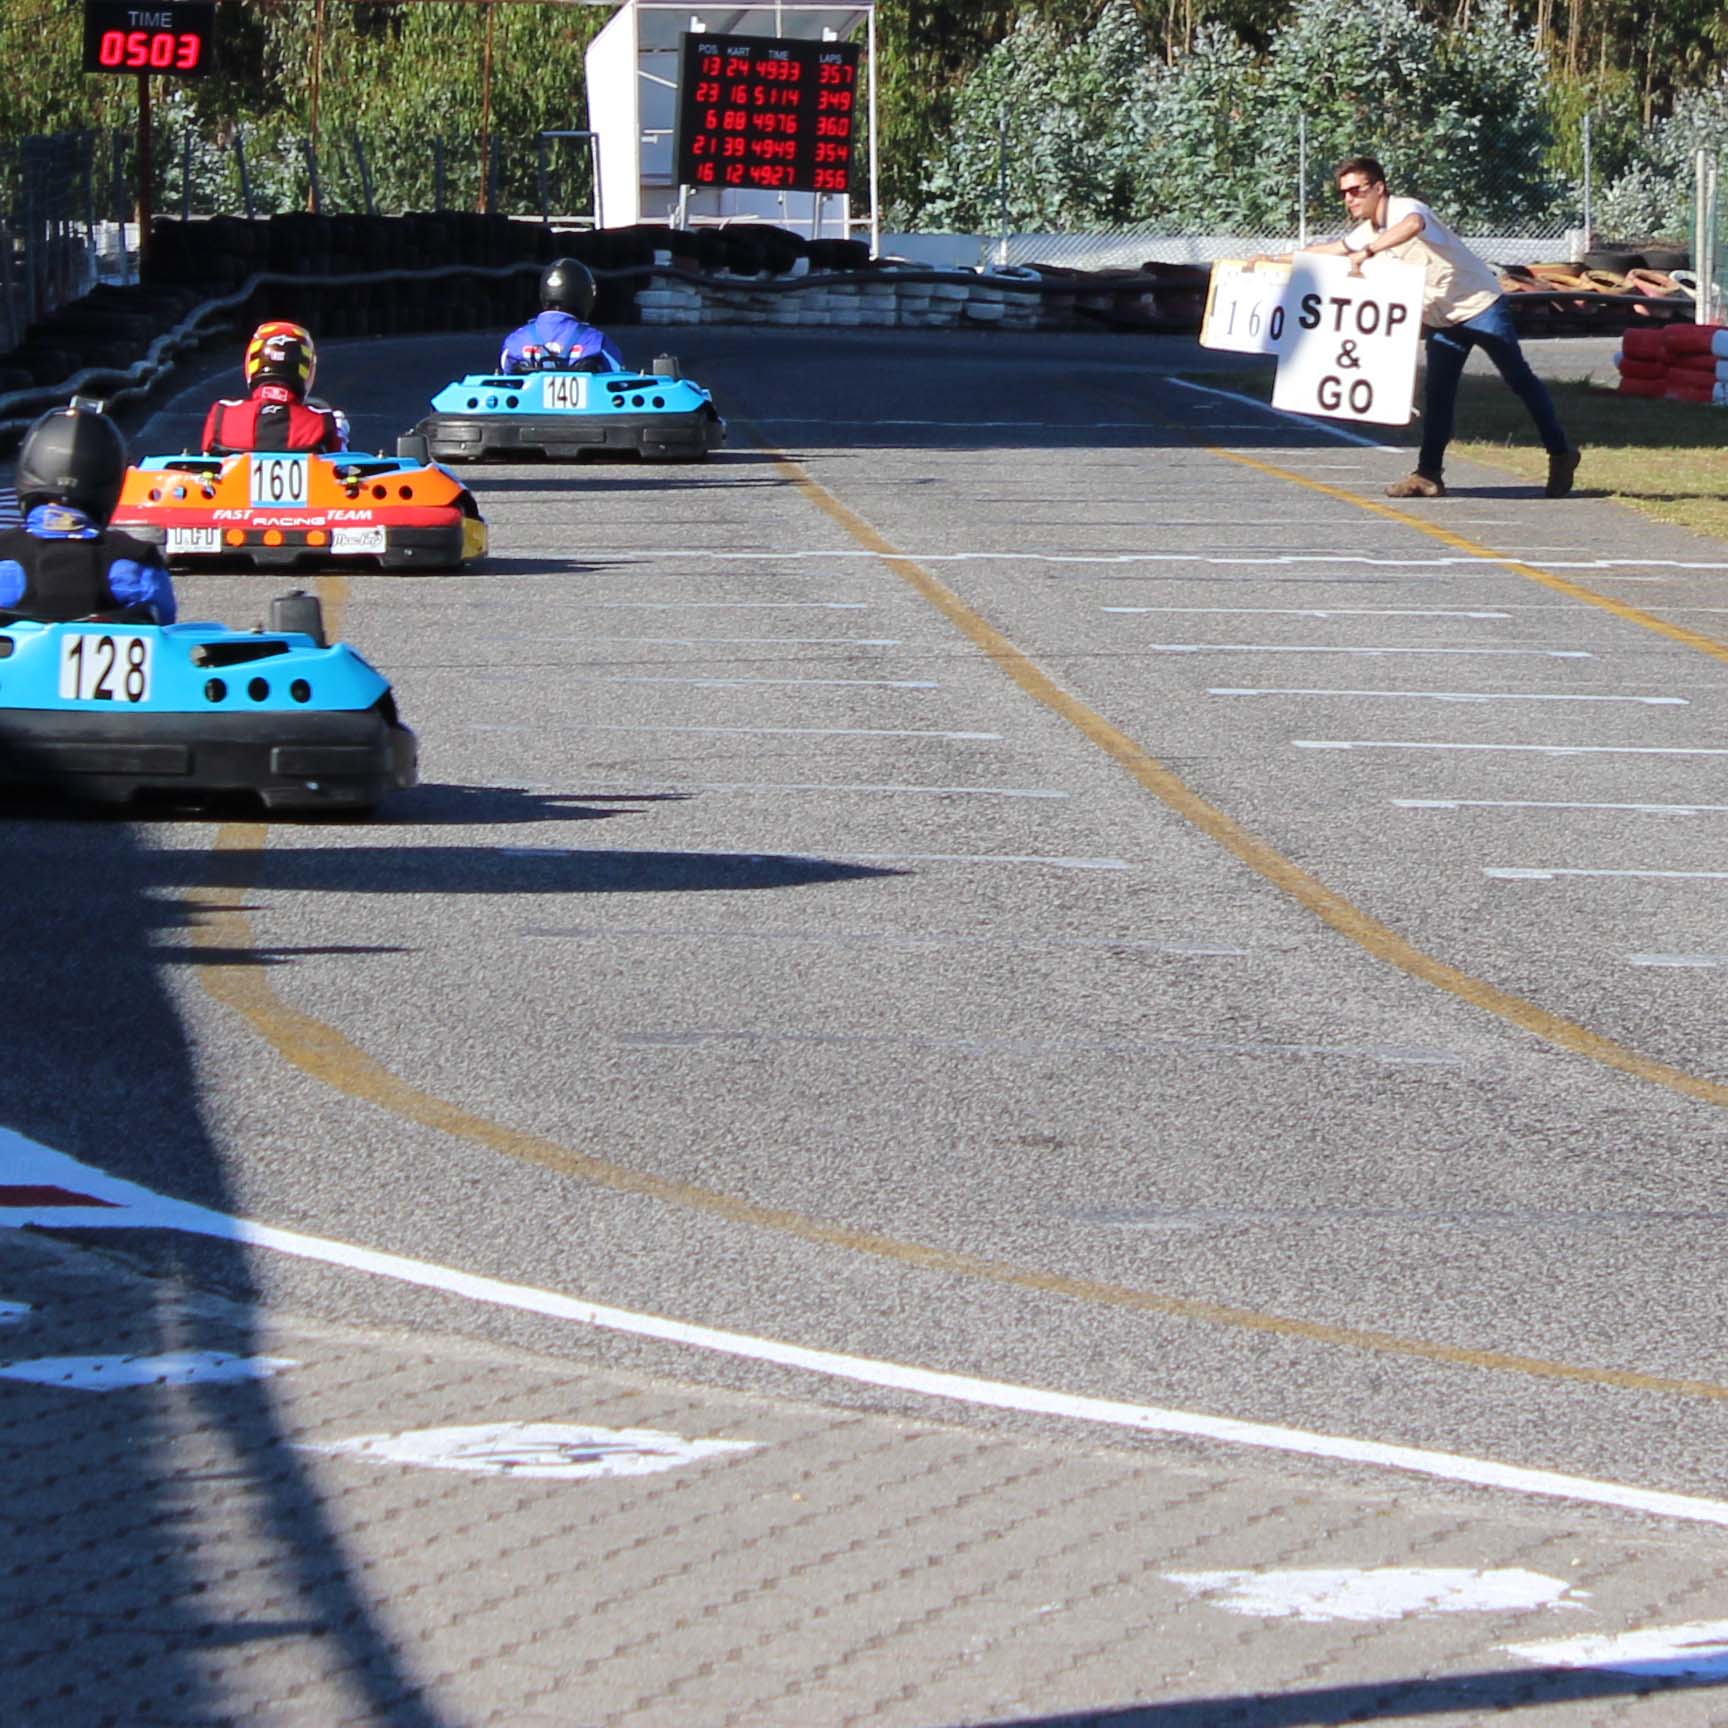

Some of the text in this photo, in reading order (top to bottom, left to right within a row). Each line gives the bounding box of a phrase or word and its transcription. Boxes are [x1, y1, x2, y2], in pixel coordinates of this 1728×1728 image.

[128, 11, 172, 28] TIME
[98, 30, 202, 70] 0503
[726, 57, 751, 78] 24
[818, 63, 854, 84] 357
[696, 82, 721, 103] 23
[730, 84, 748, 105] 16
[817, 90, 852, 111] 349
[816, 116, 850, 137] 360
[692, 135, 849, 162] 21 39 4949 354
[749, 165, 796, 187] 4927
[1226, 299, 1285, 341] 160
[1298, 293, 1408, 338] STOP
[1335, 339, 1362, 370] &
[548, 376, 580, 408] 140
[1317, 375, 1374, 415] GO
[253, 459, 303, 501] 160
[212, 509, 373, 527] FAST RACING TEAM
[68, 635, 145, 703] 128
